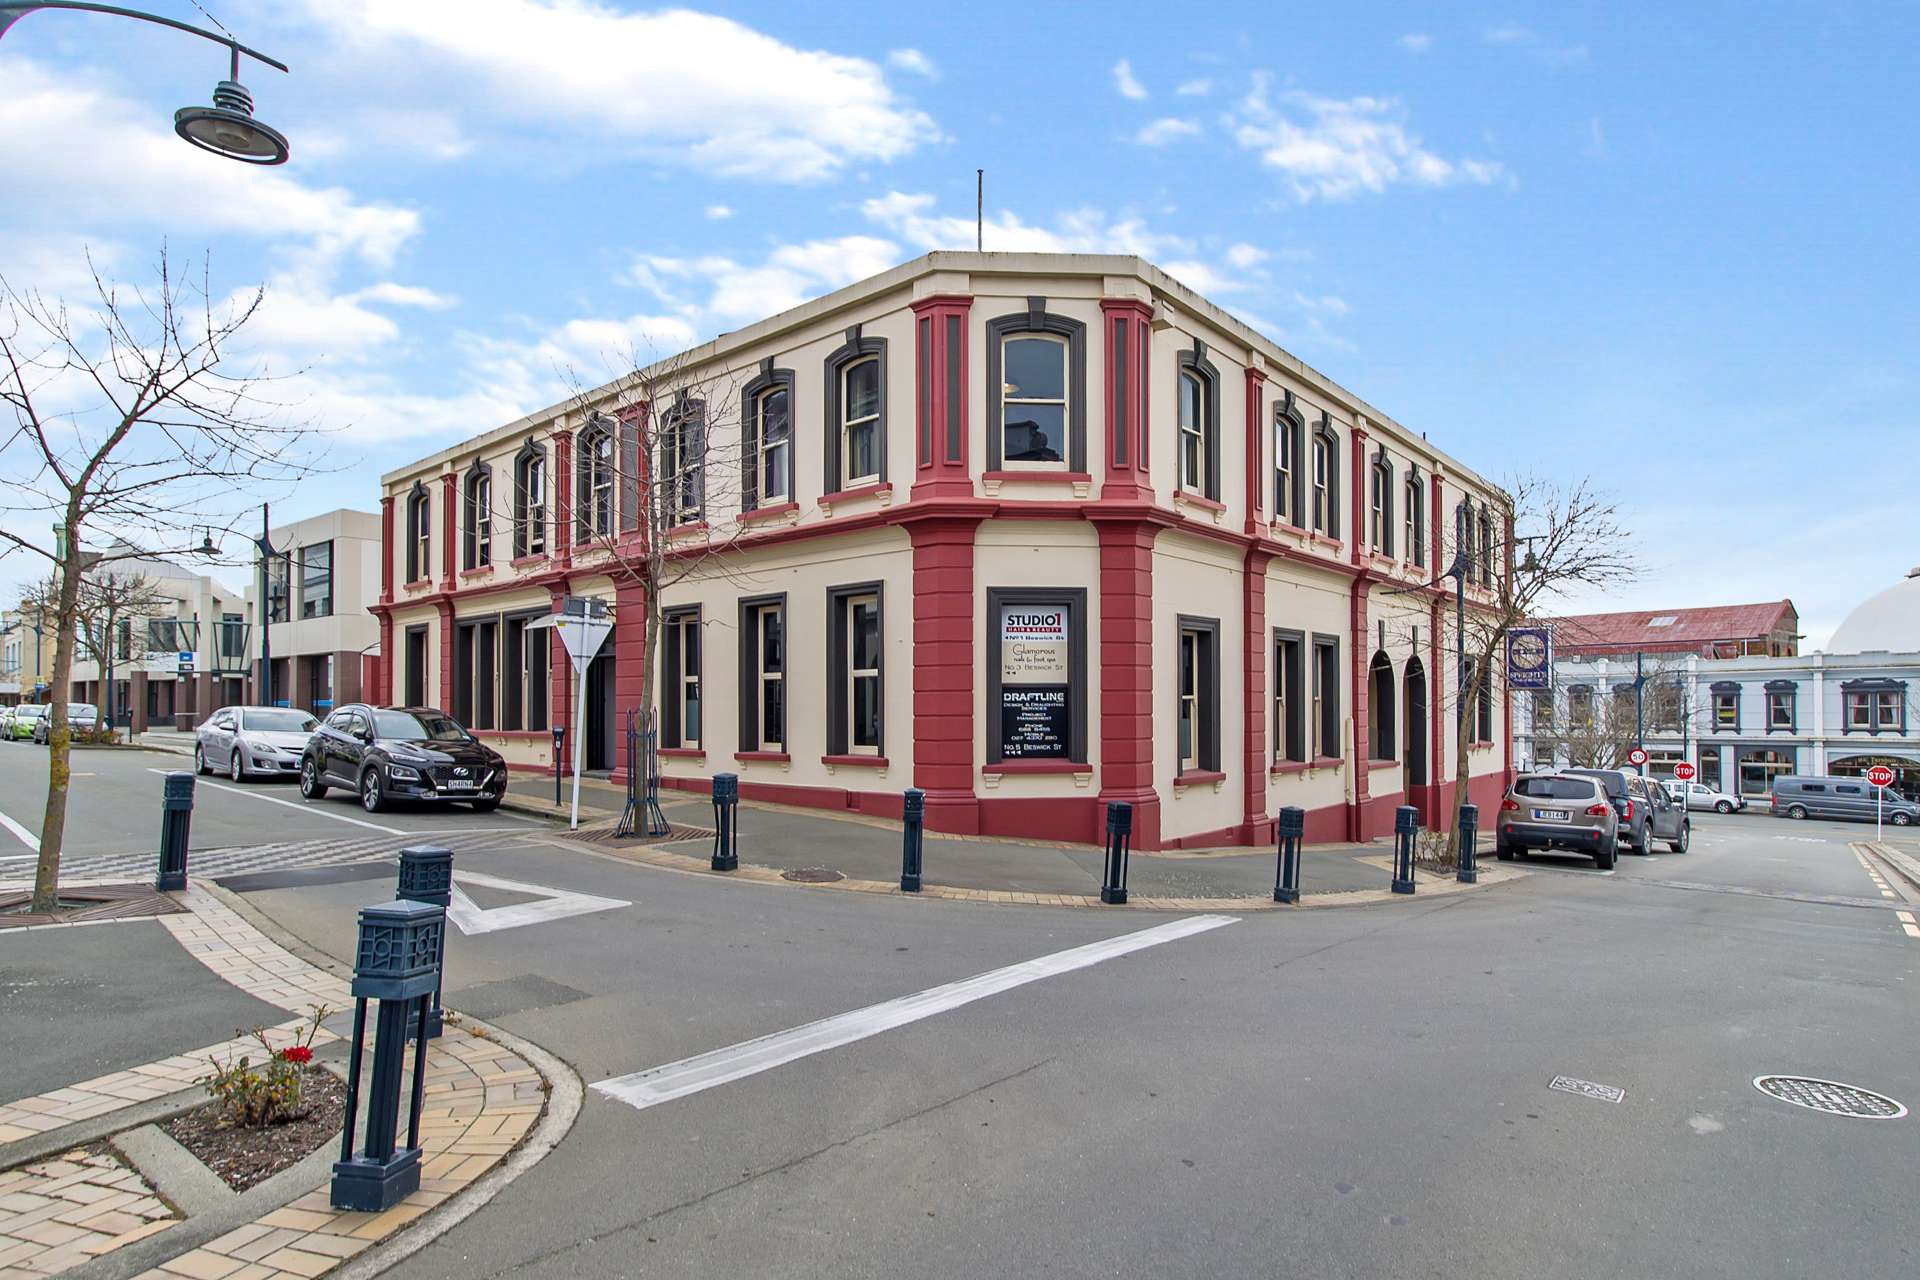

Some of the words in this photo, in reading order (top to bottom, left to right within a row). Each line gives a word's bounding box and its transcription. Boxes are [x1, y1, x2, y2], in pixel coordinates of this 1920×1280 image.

[1012, 643, 1056, 656] Glamorous
[1003, 692, 1064, 701] DRAFTLINE
[1675, 767, 1694, 776] STOP
[1868, 771, 1891, 781] STOP
